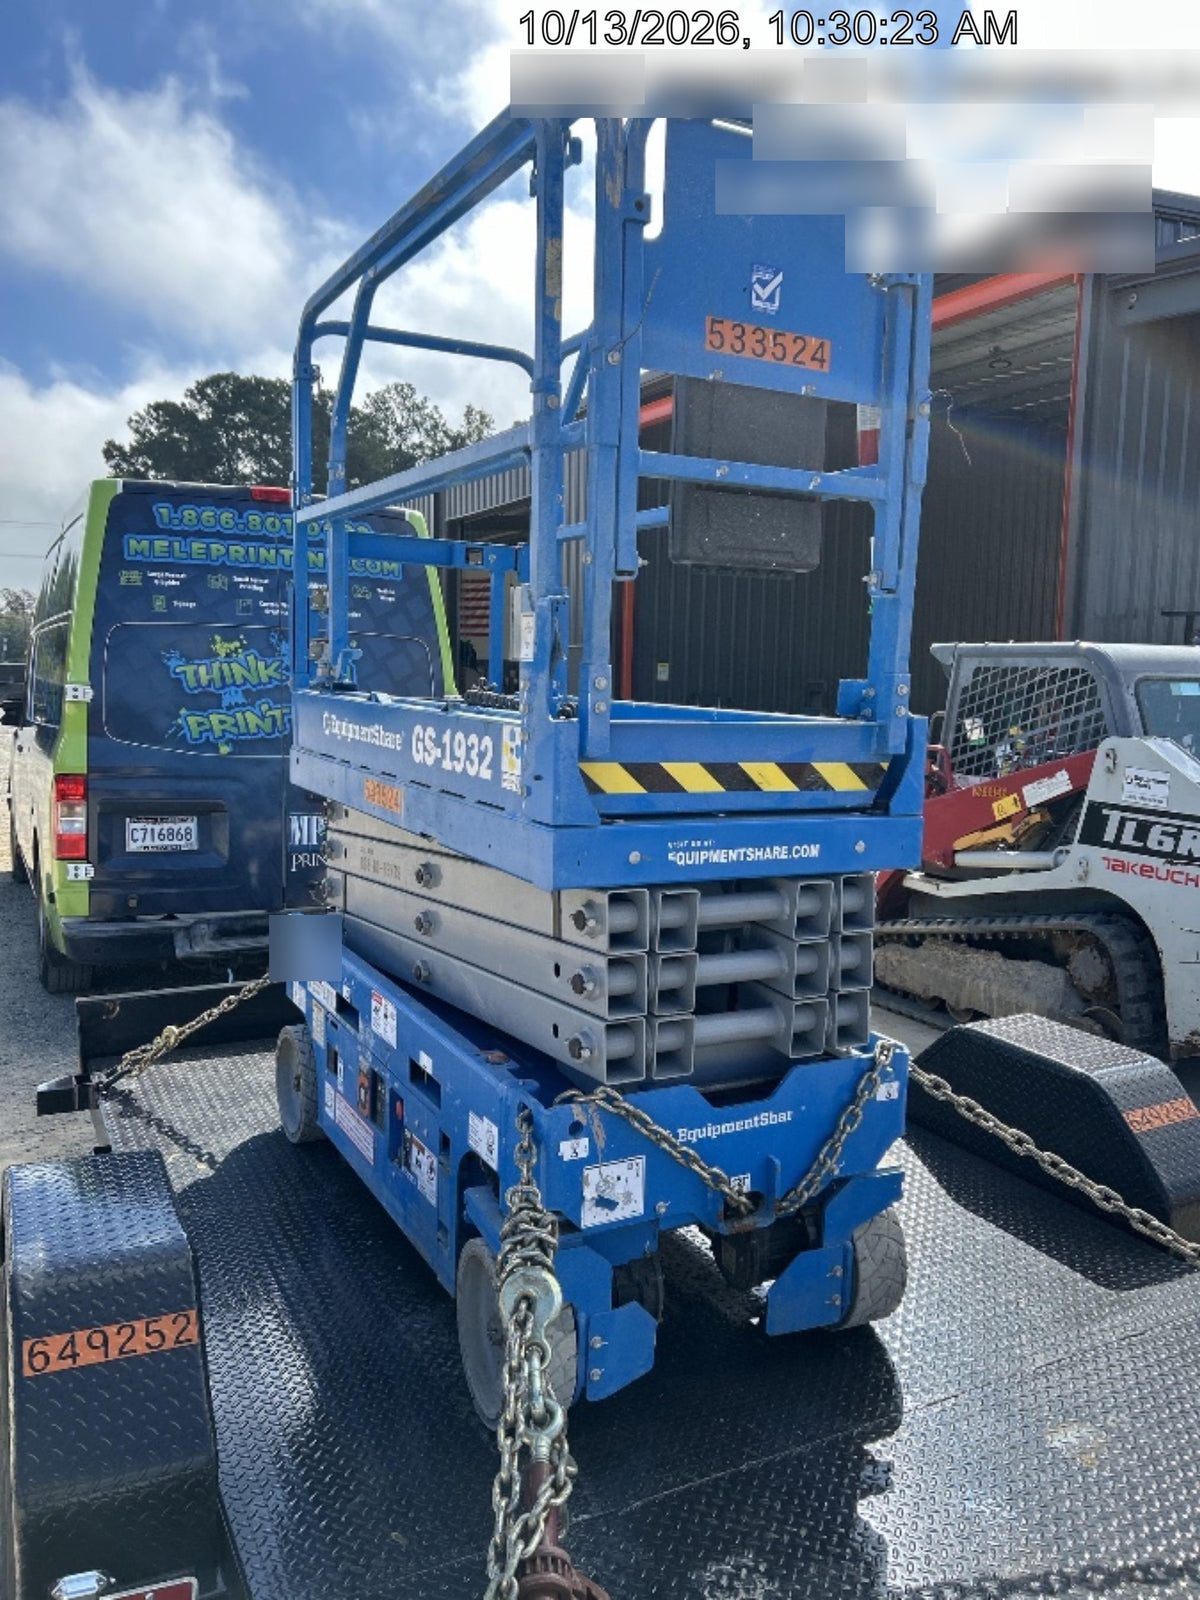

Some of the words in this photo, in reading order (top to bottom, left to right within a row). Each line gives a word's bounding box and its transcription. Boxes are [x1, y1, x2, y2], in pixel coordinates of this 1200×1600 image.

[707, 318, 829, 370] 533524
[174, 653, 286, 690] THINK
[185, 703, 291, 740] PRINT
[412, 724, 494, 781] GS-1932
[130, 826, 193, 844] C716868
[291, 852, 327, 872] PRIN
[27, 1313, 194, 1374] 649252
